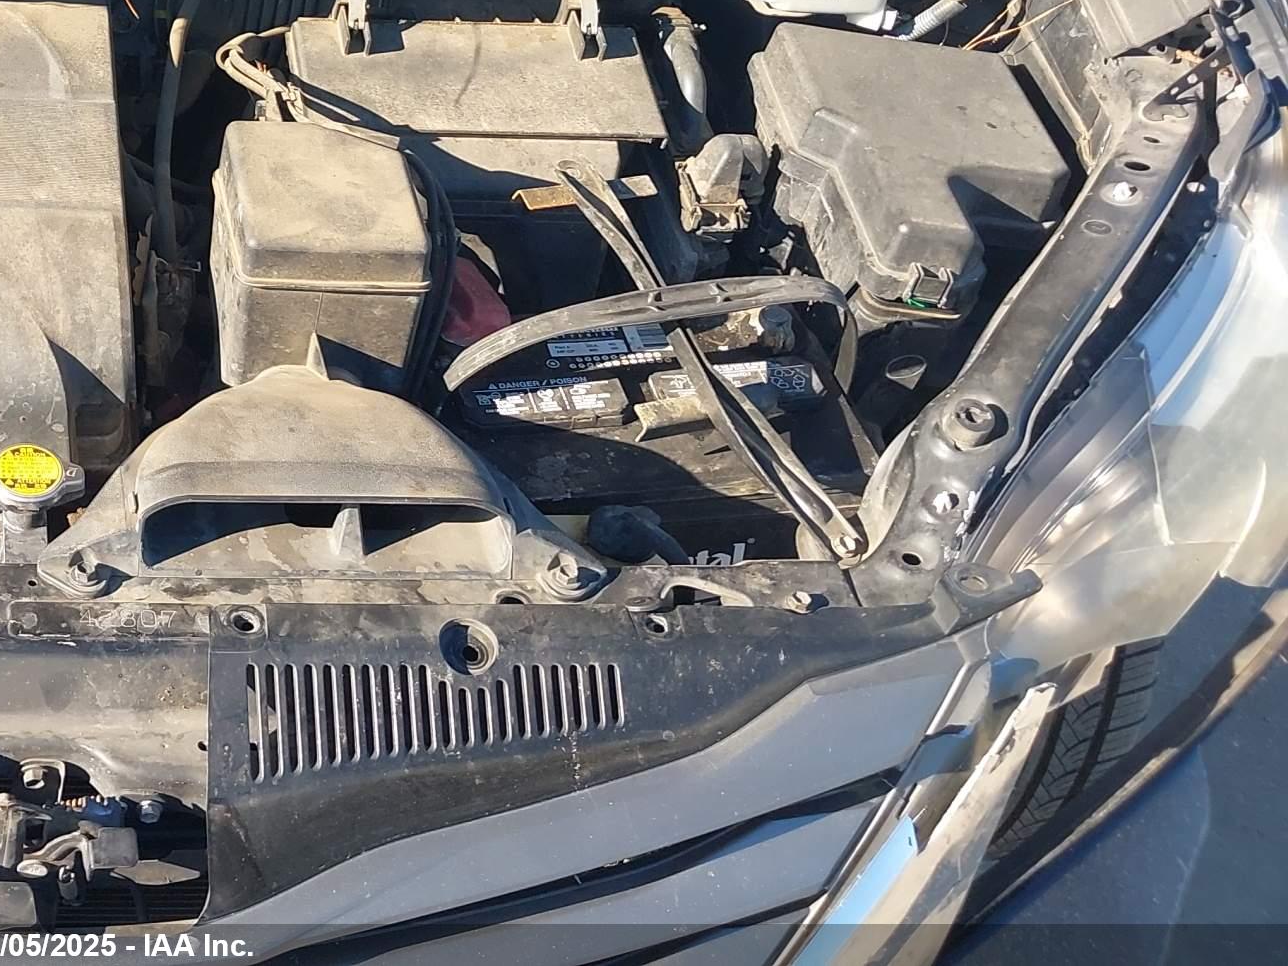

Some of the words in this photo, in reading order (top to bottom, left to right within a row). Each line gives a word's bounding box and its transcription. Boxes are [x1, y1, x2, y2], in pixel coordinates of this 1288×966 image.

[499, 379, 540, 390] DANGER
[550, 376, 588, 385] POISON
[79, 609, 178, 628] 42807
